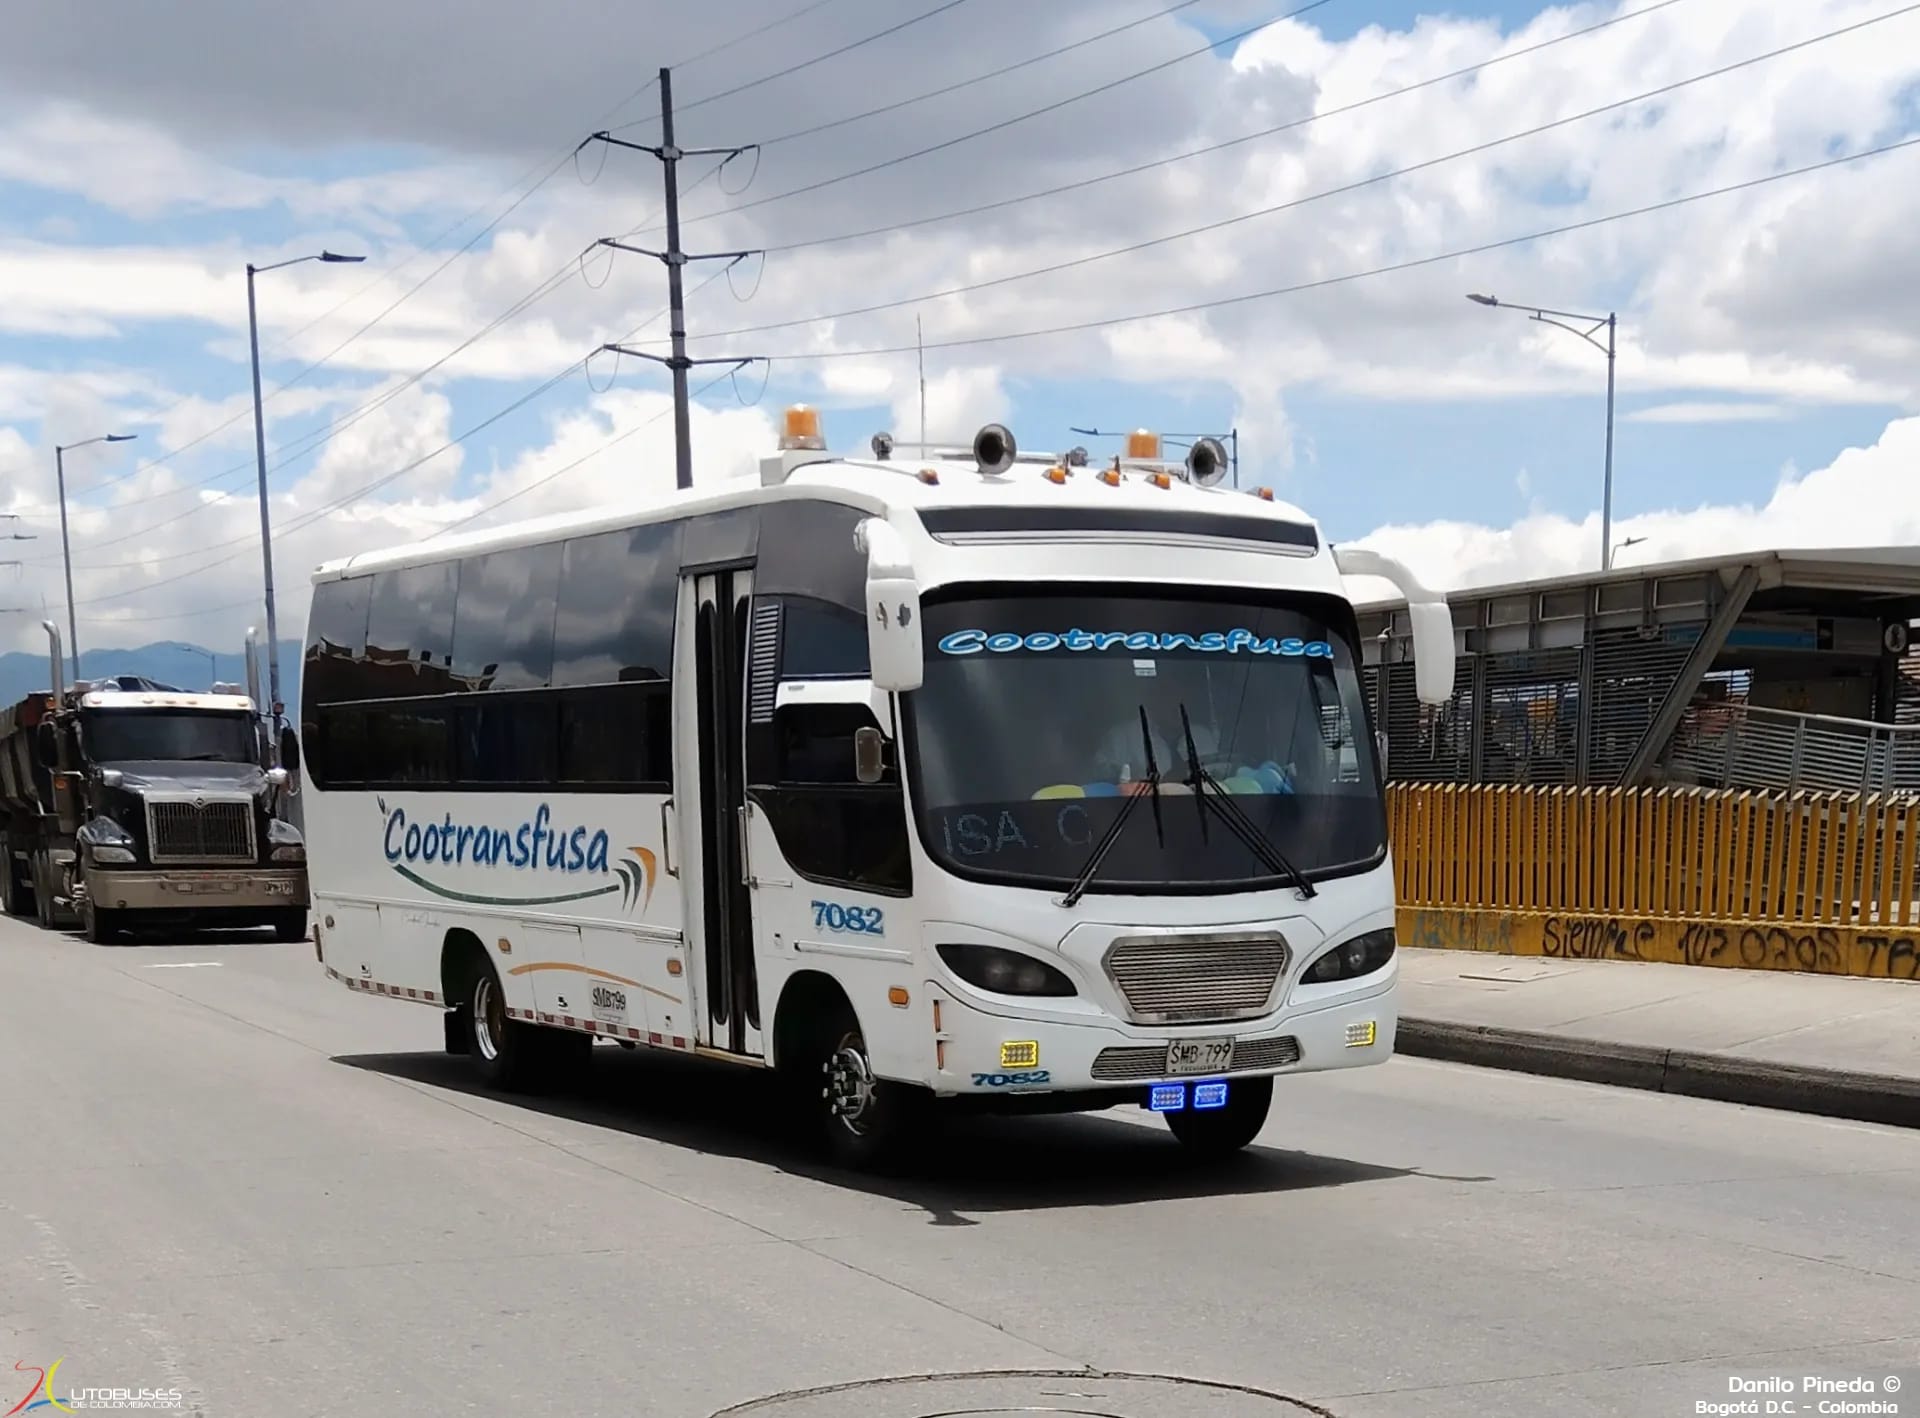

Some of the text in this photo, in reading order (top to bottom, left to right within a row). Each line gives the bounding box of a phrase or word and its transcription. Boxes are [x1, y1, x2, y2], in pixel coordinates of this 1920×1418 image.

[938, 628, 1335, 658] Cootransfusa
[384, 802, 609, 873] Cootransfusa
[811, 899, 885, 935] 7082
[970, 1070, 1051, 1086] 7082
